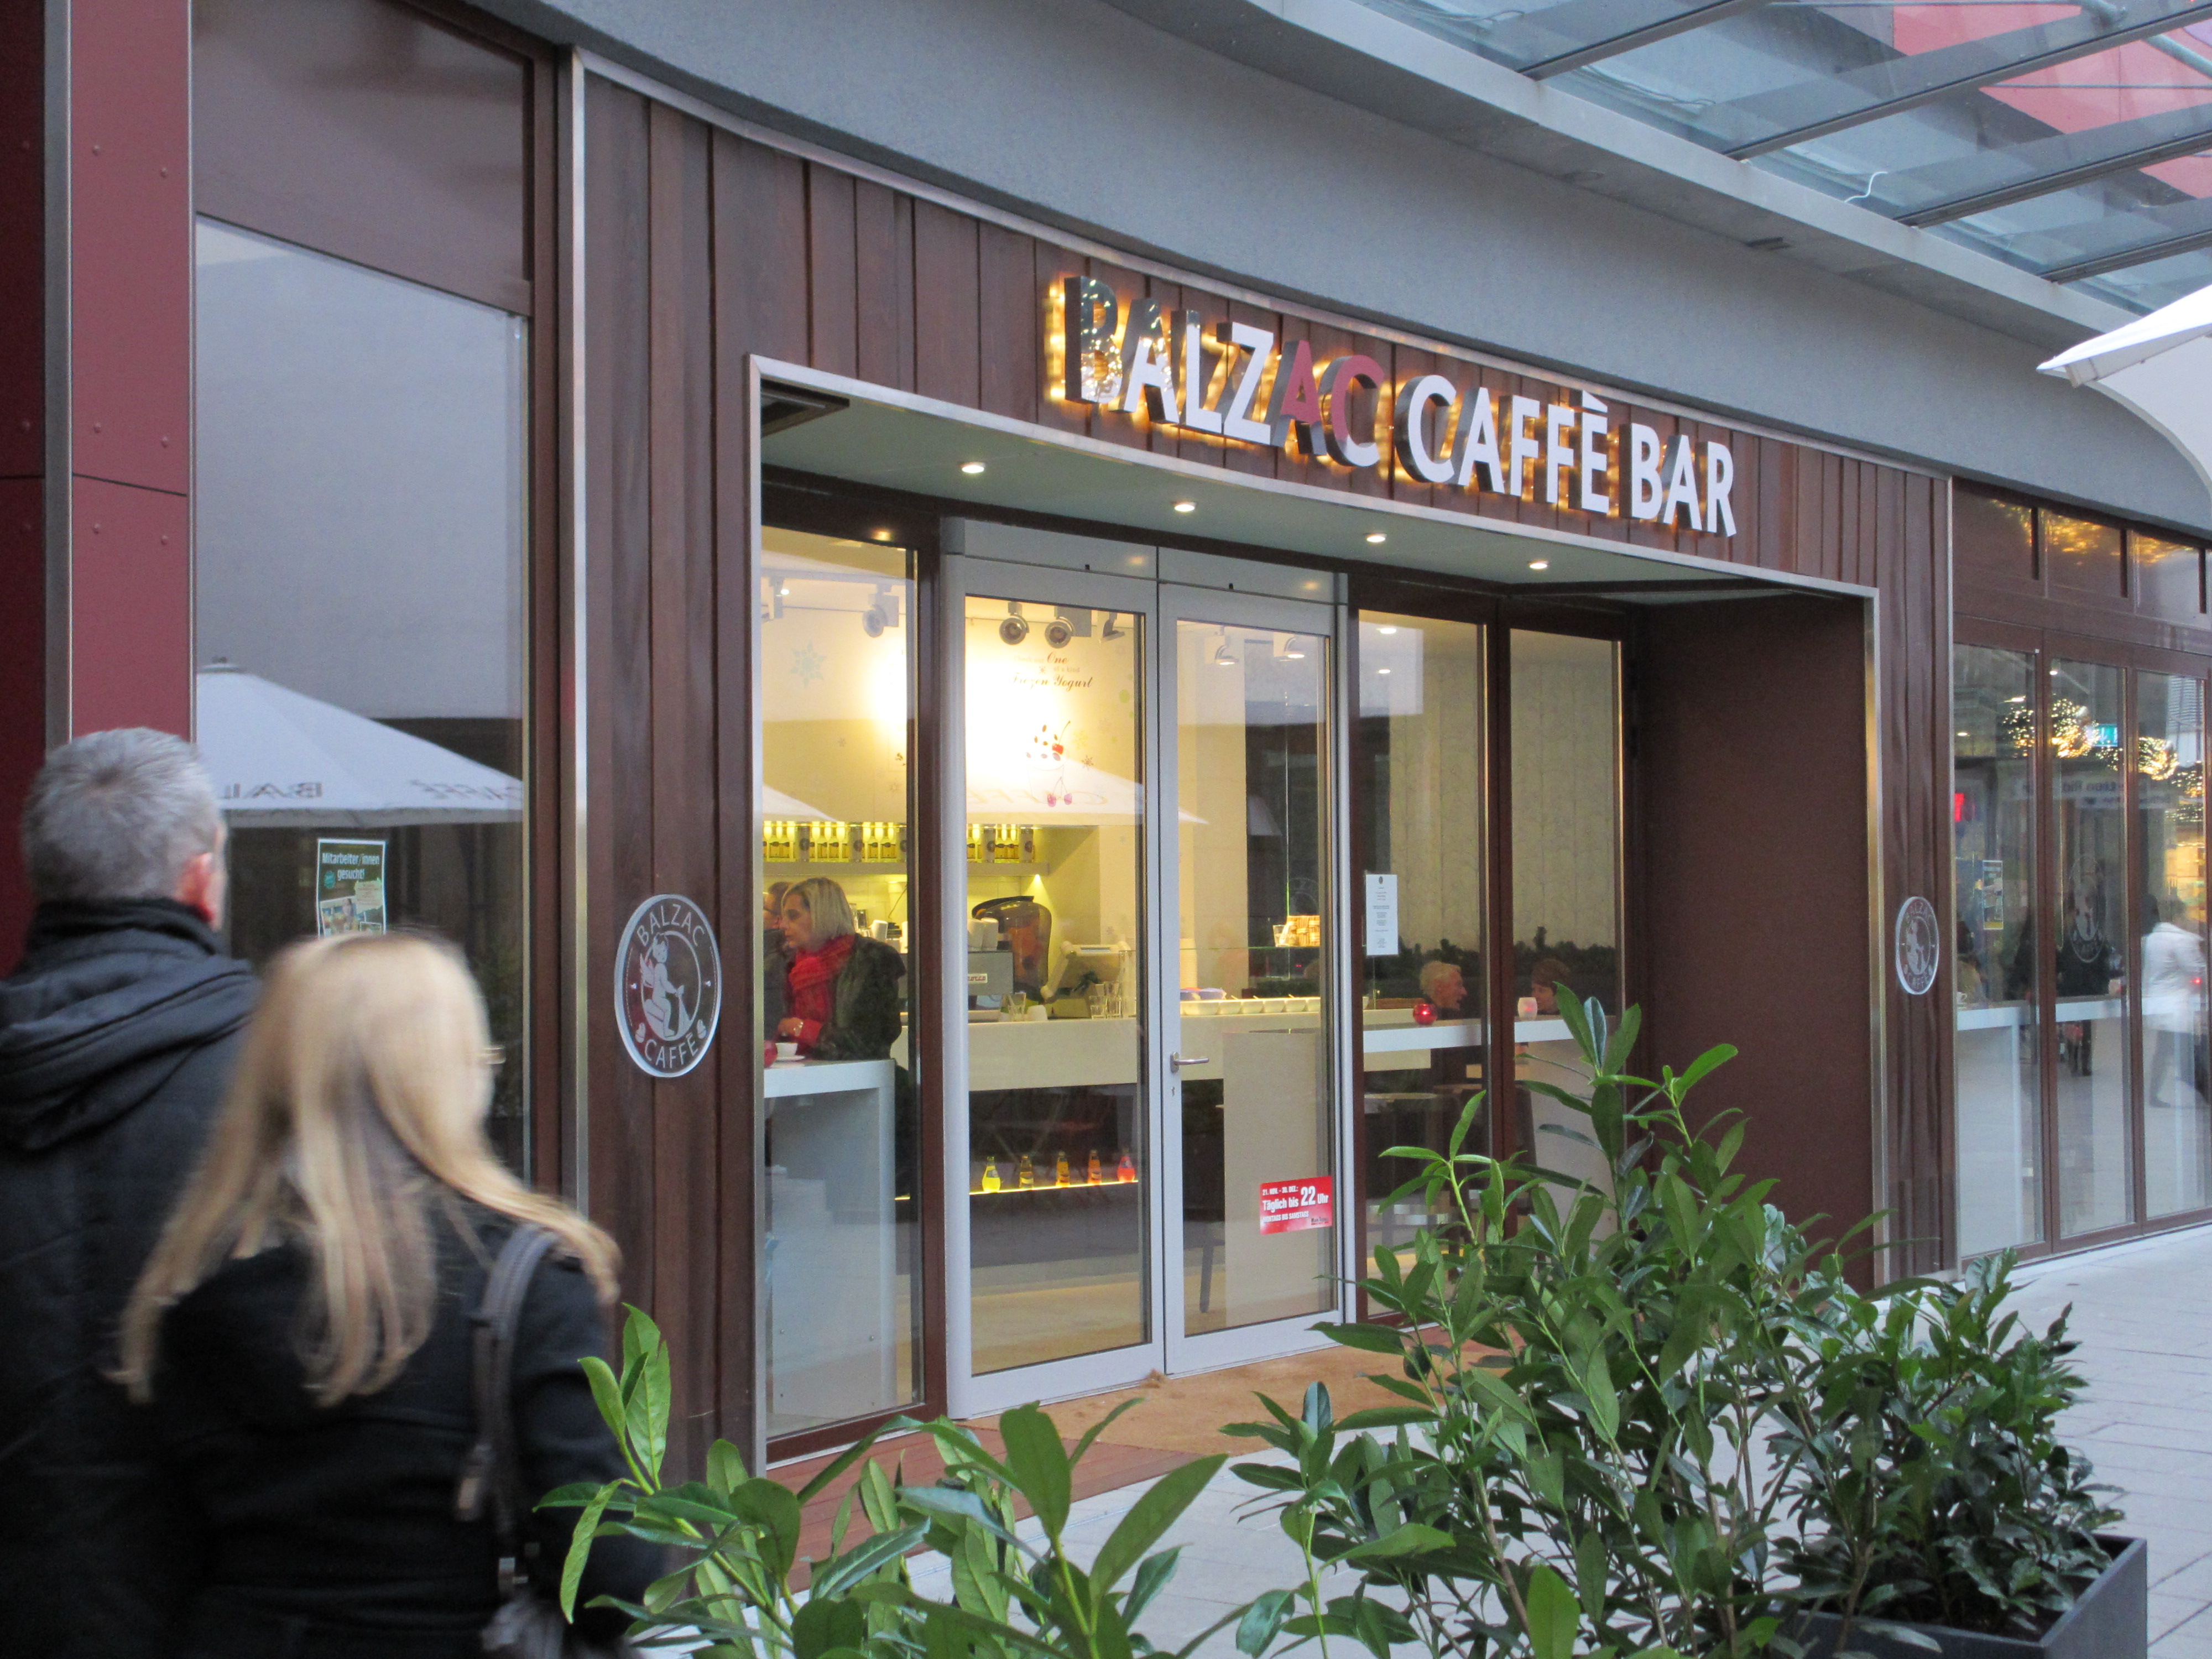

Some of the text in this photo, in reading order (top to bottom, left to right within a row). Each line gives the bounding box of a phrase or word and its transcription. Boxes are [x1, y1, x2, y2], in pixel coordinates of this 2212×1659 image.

[1065, 276, 1736, 536] BALZAC CAFFÈ BAR
[1047, 651, 1068, 664] One
[1009, 672, 1093, 692] Frozen Yogurt
[337, 868, 366, 881] gesucht!
[637, 903, 705, 947] BALZAC
[1262, 1186, 1329, 1213] Täglich bis 22 Uhr
